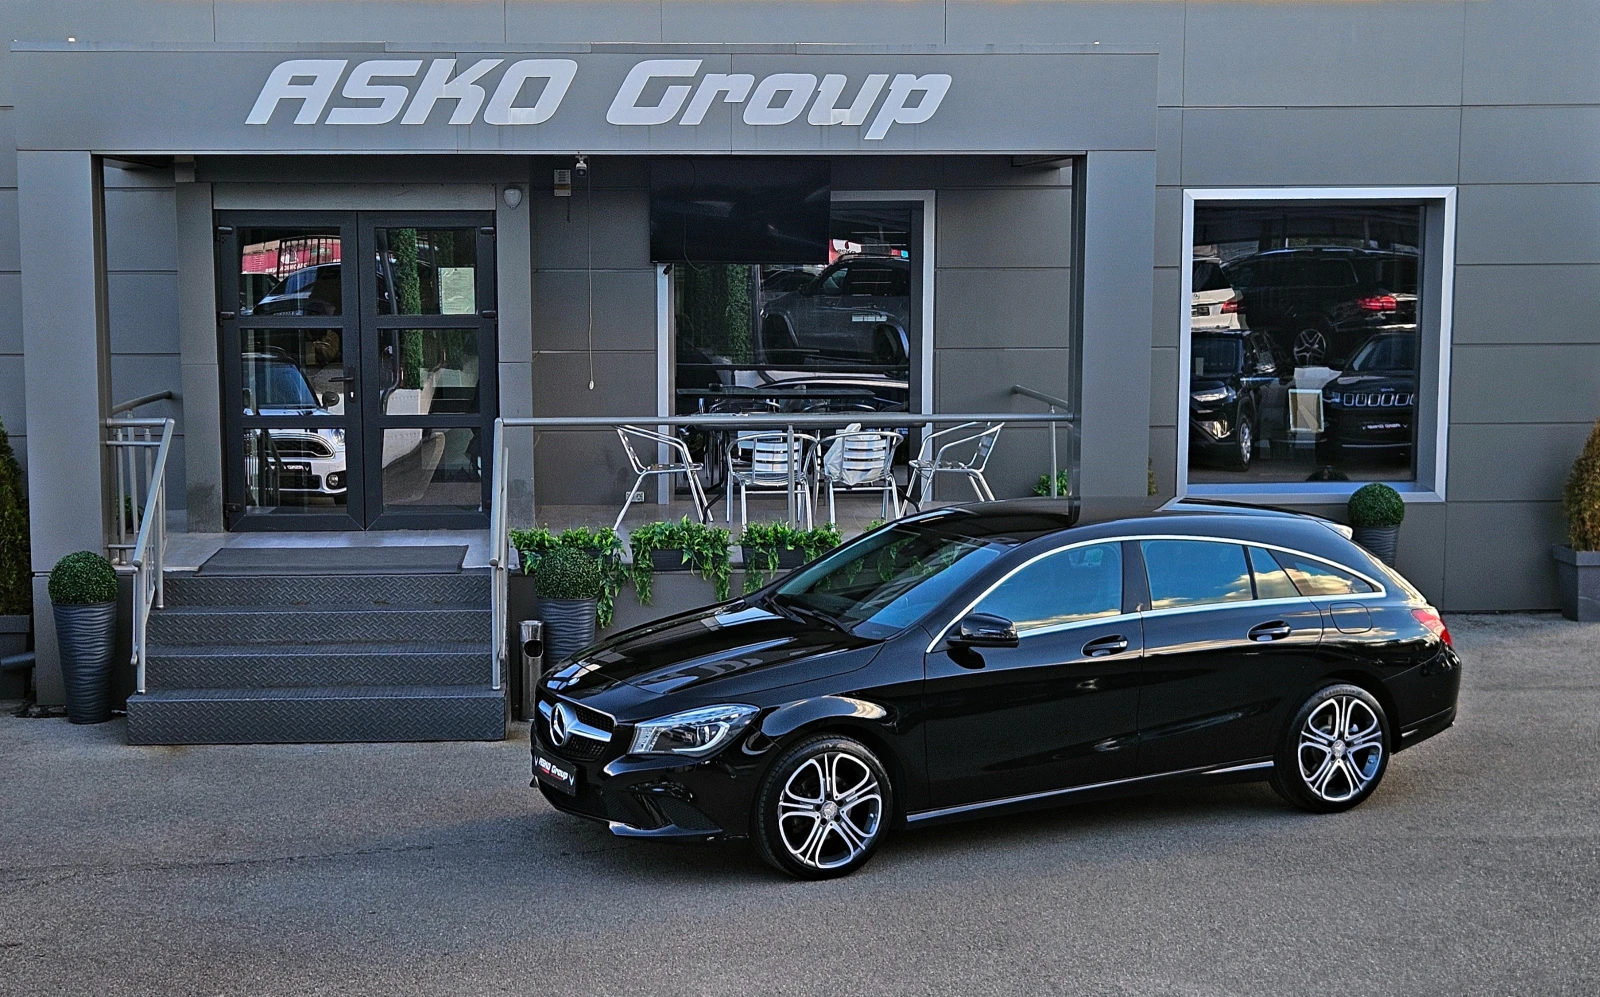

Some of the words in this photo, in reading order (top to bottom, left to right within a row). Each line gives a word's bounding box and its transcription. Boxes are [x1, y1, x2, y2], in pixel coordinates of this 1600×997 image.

[244, 59, 578, 125] ASKO
[606, 59, 952, 140] Group
[551, 764, 569, 781] Group
